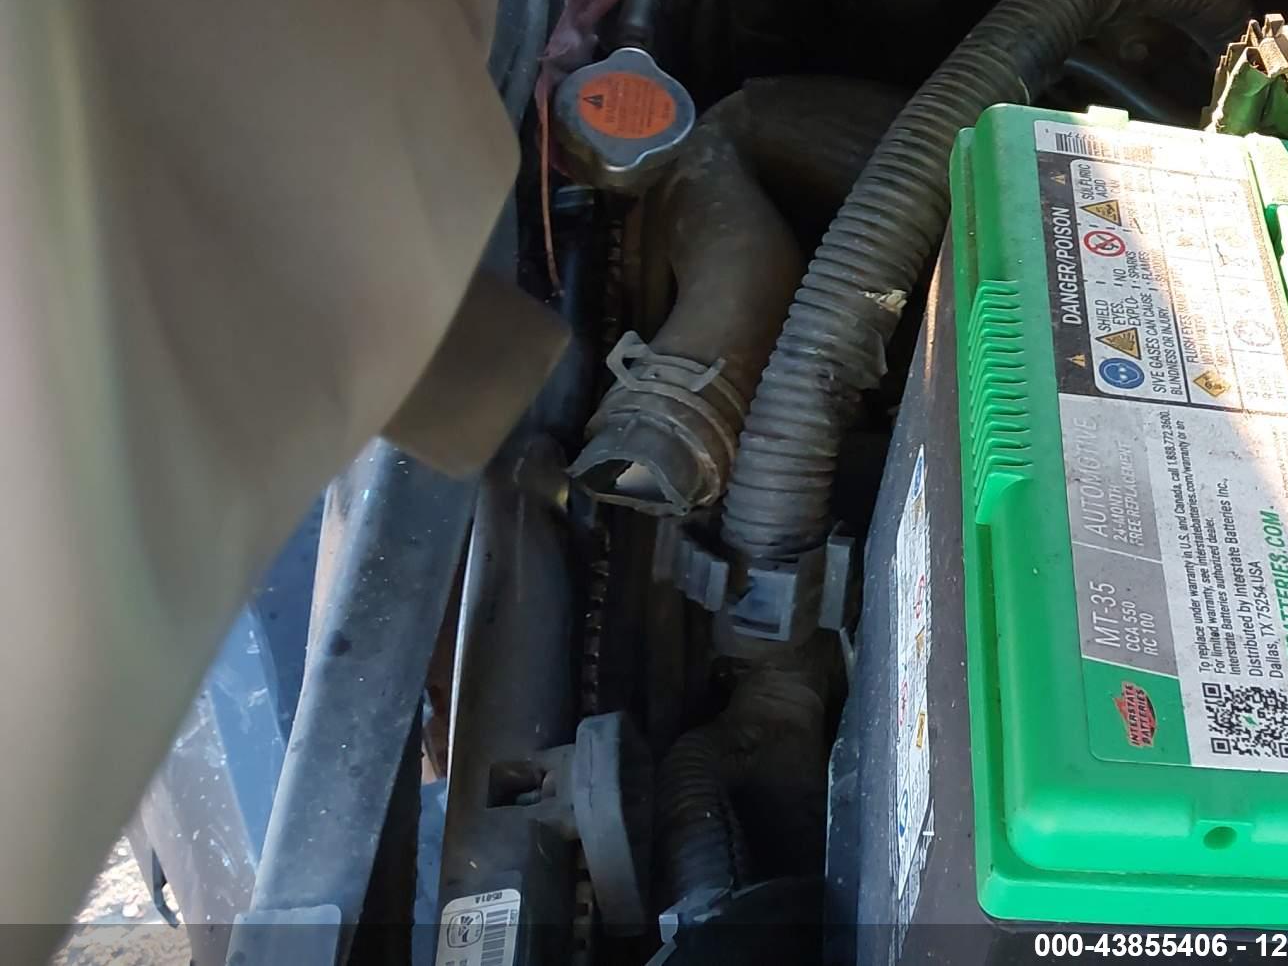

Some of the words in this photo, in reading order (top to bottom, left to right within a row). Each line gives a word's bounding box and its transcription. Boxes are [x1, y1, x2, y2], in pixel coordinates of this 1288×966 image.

[1077, 163, 1094, 199] SULFURIC
[1094, 179, 1107, 197] ACID
[1051, 206, 1081, 324] DANGER/POISON
[1112, 268, 1126, 281] NO
[1124, 250, 1139, 279] SPARKS
[1138, 251, 1153, 280] FLAMES
[1094, 299, 1111, 332] SHIELD
[1124, 295, 1141, 325] EXPLO-
[1139, 292, 1154, 317] CAUSE
[1143, 319, 1157, 335] CAN
[1157, 306, 1172, 334] INJURY.
[1178, 314, 1193, 334] EYES
[1144, 337, 1162, 368] GASES
[1162, 335, 1174, 347] OR
[1182, 336, 1199, 363] FLUSH
[1150, 371, 1166, 392] SIVE
[1164, 348, 1182, 394] BLINDNESS
[1073, 417, 1108, 537] AUTOMOTIVE
[1118, 441, 1140, 517] REPLACEMENT
[1168, 467, 1180, 481] call
[1170, 482, 1186, 513] Canada,
[1177, 441, 1208, 565] interstatebatteries.com/warranty
[1127, 518, 1144, 545] FREE
[1175, 515, 1188, 530] and
[1203, 517, 1217, 543] dealer.
[1217, 500, 1238, 543] Batteries
[1178, 532, 1191, 548] U.S.
[1181, 550, 1192, 558] in
[1183, 560, 1203, 596] warranty
[1200, 568, 1210, 583] see
[1208, 545, 1225, 588] authorized
[1226, 546, 1248, 596] Interstate
[1246, 560, 1264, 582] USA
[1089, 580, 1121, 646] MT-35
[1121, 600, 1137, 623] 550
[1187, 598, 1203, 623] under
[1201, 585, 1219, 624] warranty,
[1216, 591, 1233, 629] Batteries
[1235, 600, 1253, 612] by
[1251, 585, 1271, 618] 75254
[1139, 611, 1155, 634] 100
[1258, 622, 1274, 636] TX
[1124, 626, 1141, 651] CCA
[1142, 637, 1158, 655] RC
[1192, 626, 1211, 659] replace
[1207, 625, 1223, 656] limited
[1223, 631, 1241, 674] Interstate
[1238, 615, 1263, 676] Distributed
[1197, 661, 1210, 672] To
[1212, 658, 1226, 673] For
[1262, 640, 1284, 678] Dallas,
[1124, 684, 1140, 745] INTERSTATE
[1135, 689, 1151, 744] BATTERIES
